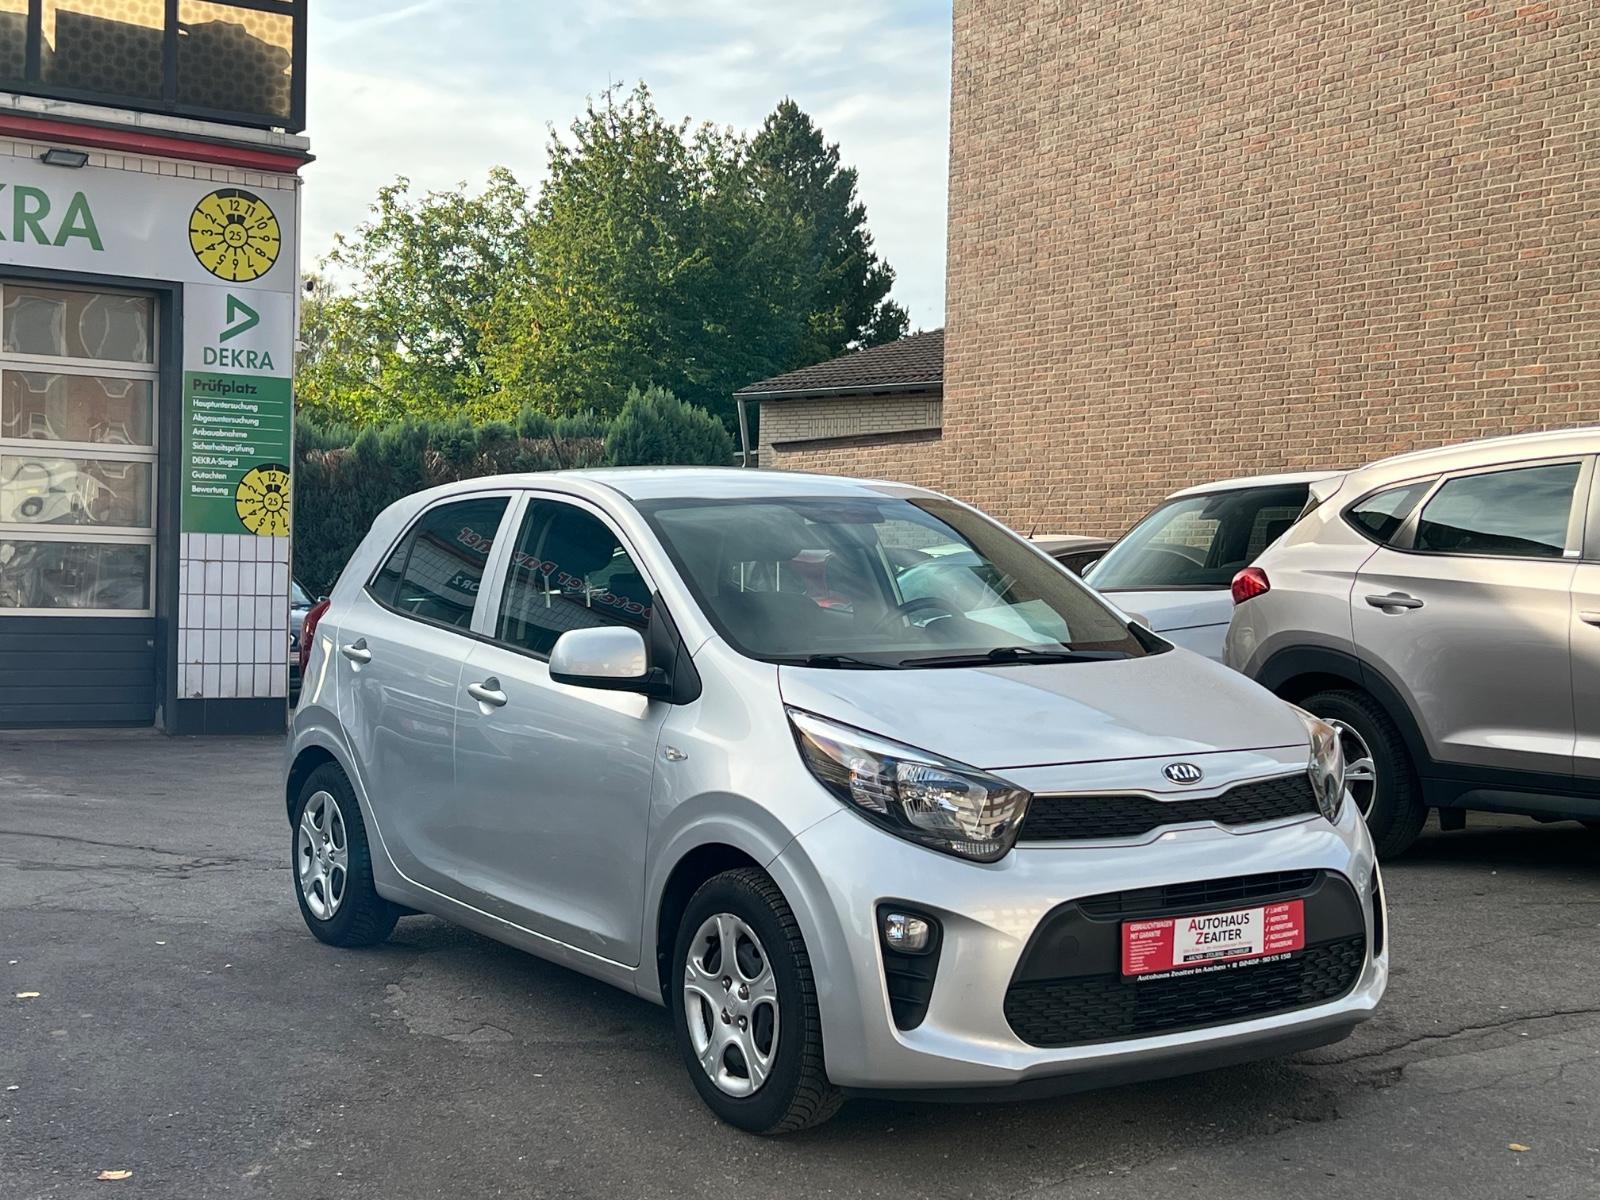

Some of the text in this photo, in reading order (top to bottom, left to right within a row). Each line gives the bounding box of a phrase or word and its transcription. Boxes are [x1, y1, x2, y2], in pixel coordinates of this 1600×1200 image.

[217, 204, 225, 215] 1
[229, 200, 240, 211] 12
[244, 204, 256, 217] 11
[0, 184, 104, 251] RA
[204, 213, 217, 224] 2
[254, 216, 268, 230] 10
[201, 229, 213, 237] 3
[229, 230, 241, 241] 25
[255, 247, 266, 257] 8
[216, 254, 226, 265] 5
[232, 258, 239, 270] 6
[248, 256, 254, 268] 7
[203, 346, 274, 371] DEKRA
[192, 378, 257, 395] Prüfplatz
[192, 399, 258, 412] Hauptuntersuchung
[192, 428, 248, 438] Anbauabnahme
[192, 442, 255, 455] Sicherheitsprüfung
[192, 456, 238, 467] DEKRA-Siegel
[192, 471, 227, 480] Gutachten
[258, 476, 264, 486] 1
[268, 473, 277, 482] 12
[191, 485, 229, 495] Bewertung
[248, 485, 258, 494] 2
[268, 497, 278, 506] 25
[258, 518, 266, 527] 5
[271, 520, 276, 530] 6
[1168, 765, 1200, 780] KIA
[1188, 913, 1250, 932] AUTOHAUS
[1196, 928, 1242, 945] ZEAITER
[1137, 972, 1170, 981] Autohaus
[1171, 968, 1194, 977] Zeaiter
[1203, 964, 1226, 973] Aachen
